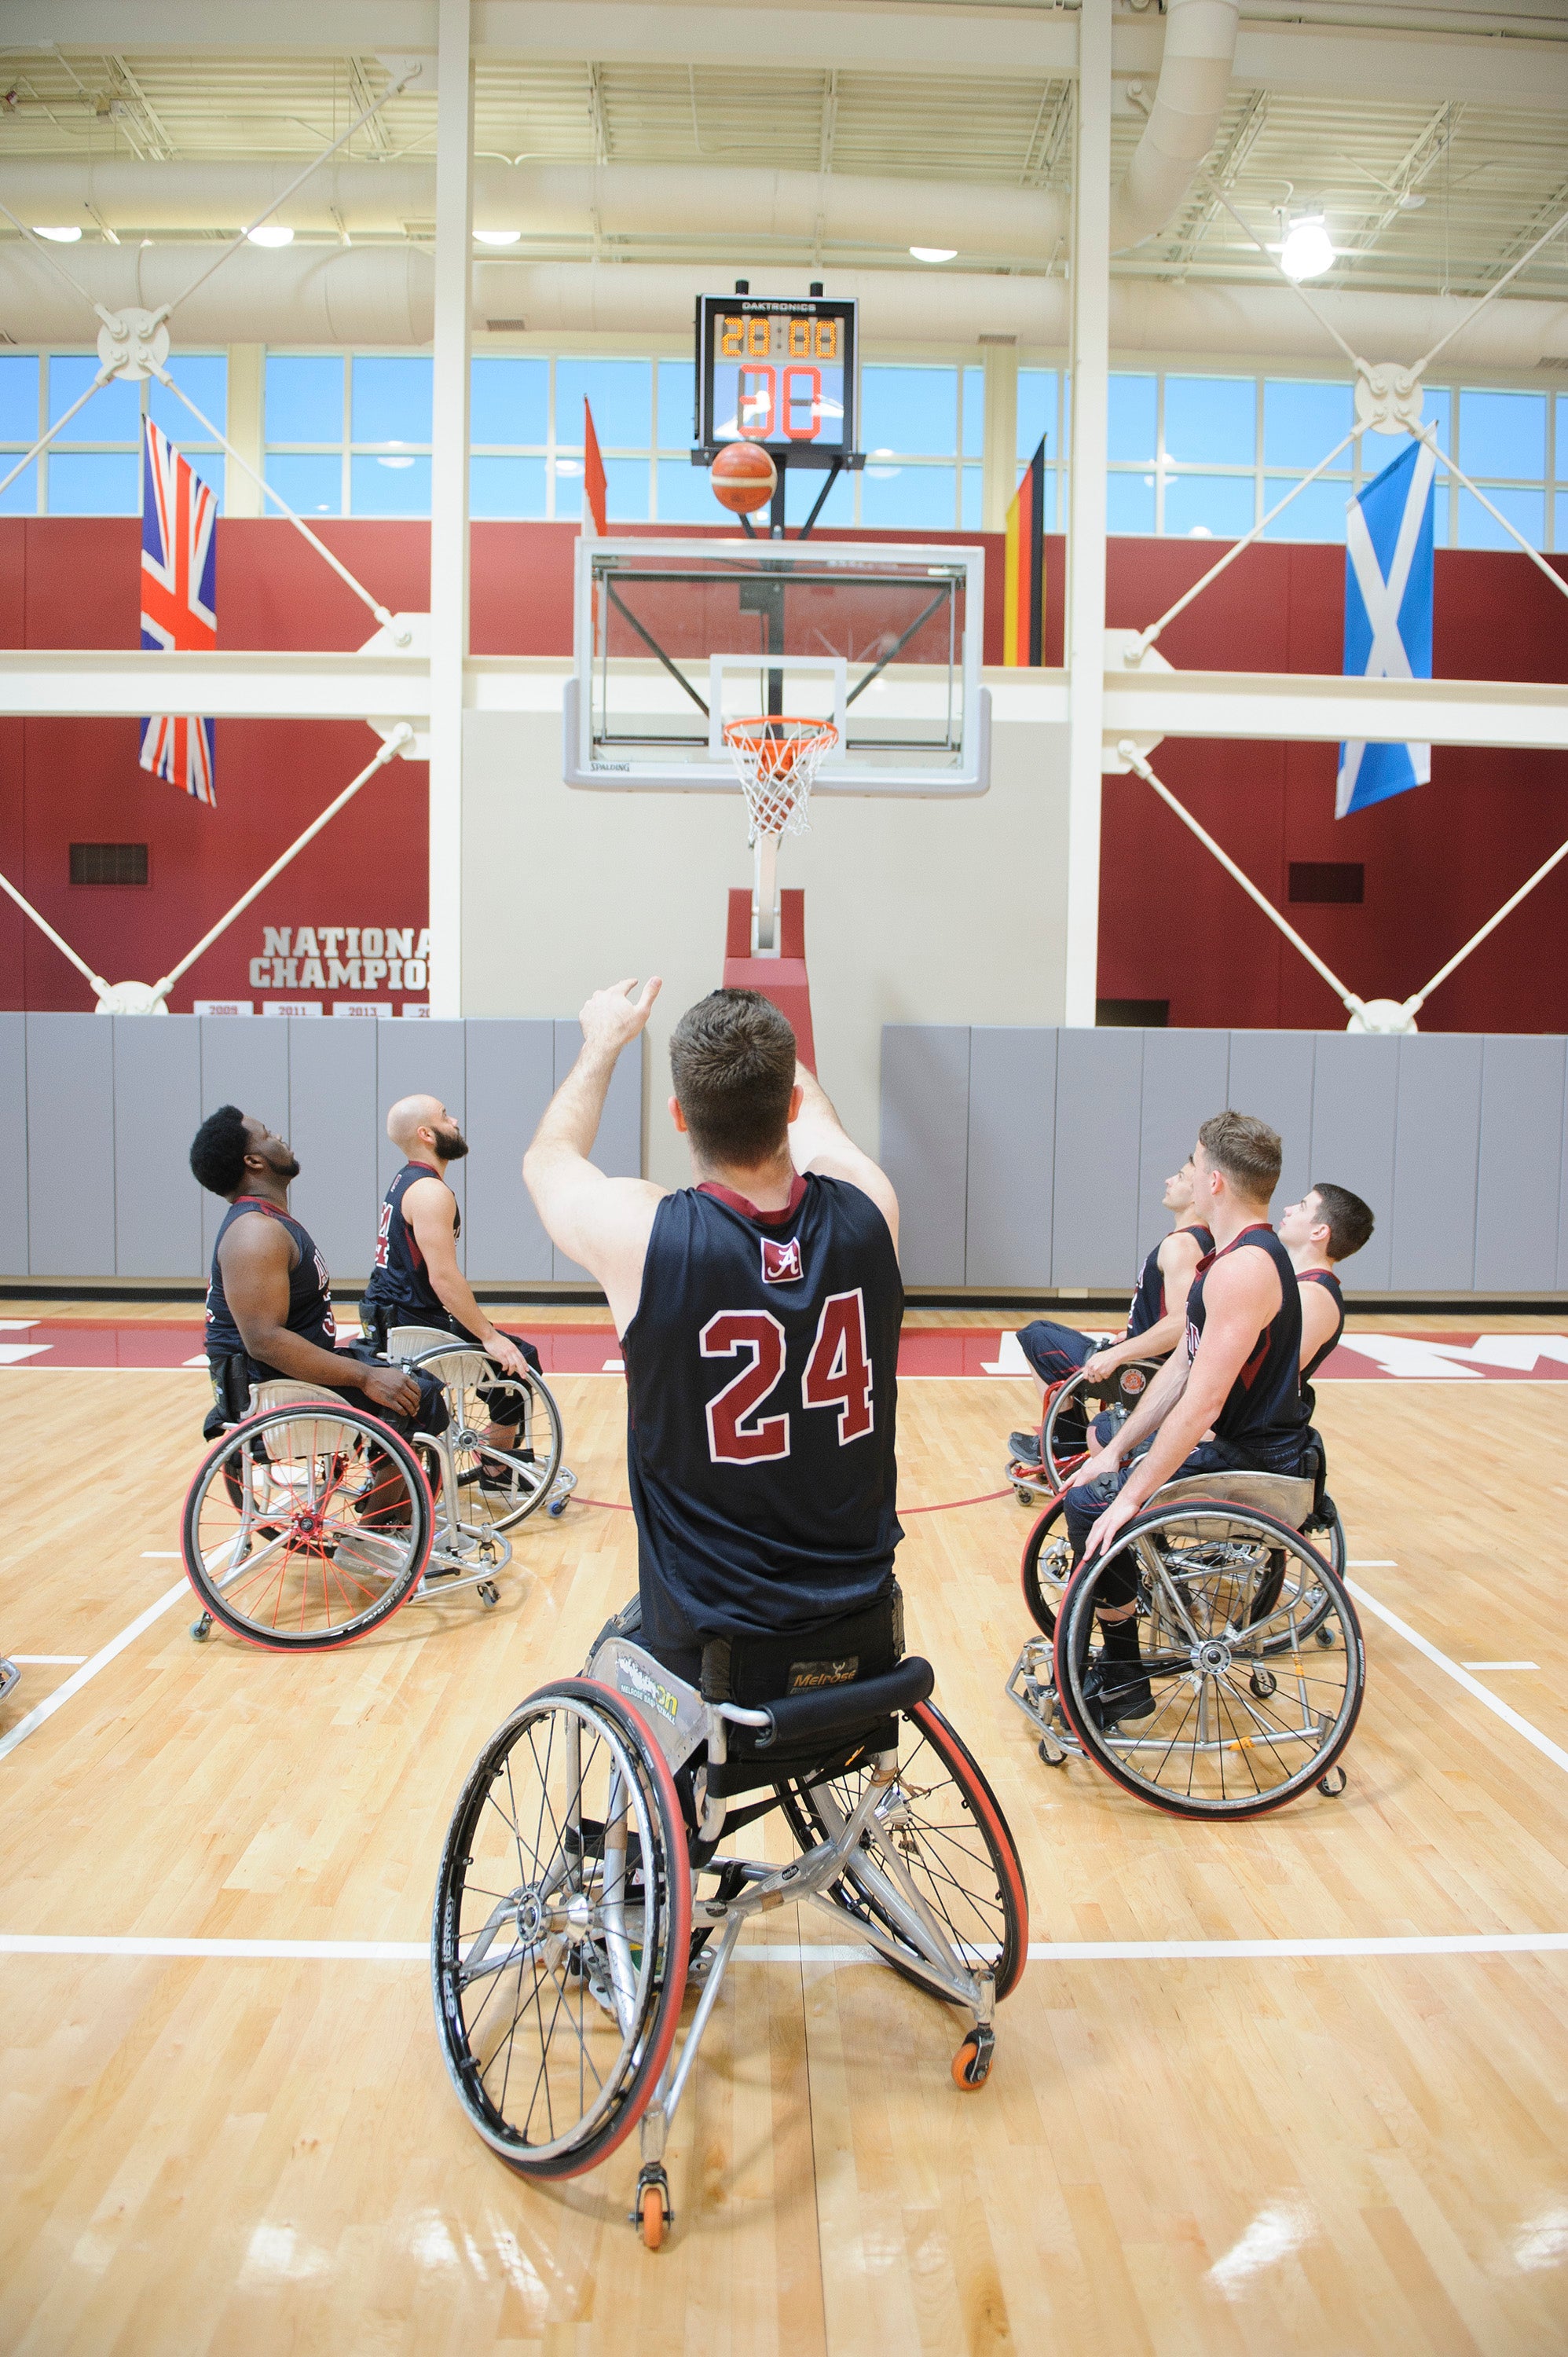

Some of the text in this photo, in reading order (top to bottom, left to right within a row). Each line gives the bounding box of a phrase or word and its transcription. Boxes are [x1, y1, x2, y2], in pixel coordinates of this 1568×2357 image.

[742, 302, 816, 312] DAKTRONICS
[737, 364, 822, 439] 30
[591, 762, 629, 772] SPALDING
[249, 957, 430, 990] CHAMPIO
[278, 1006, 306, 1015] 2011
[348, 1006, 377, 1016] 2013
[699, 1287, 874, 1465] 24
[793, 1670, 856, 1688] Melrose
